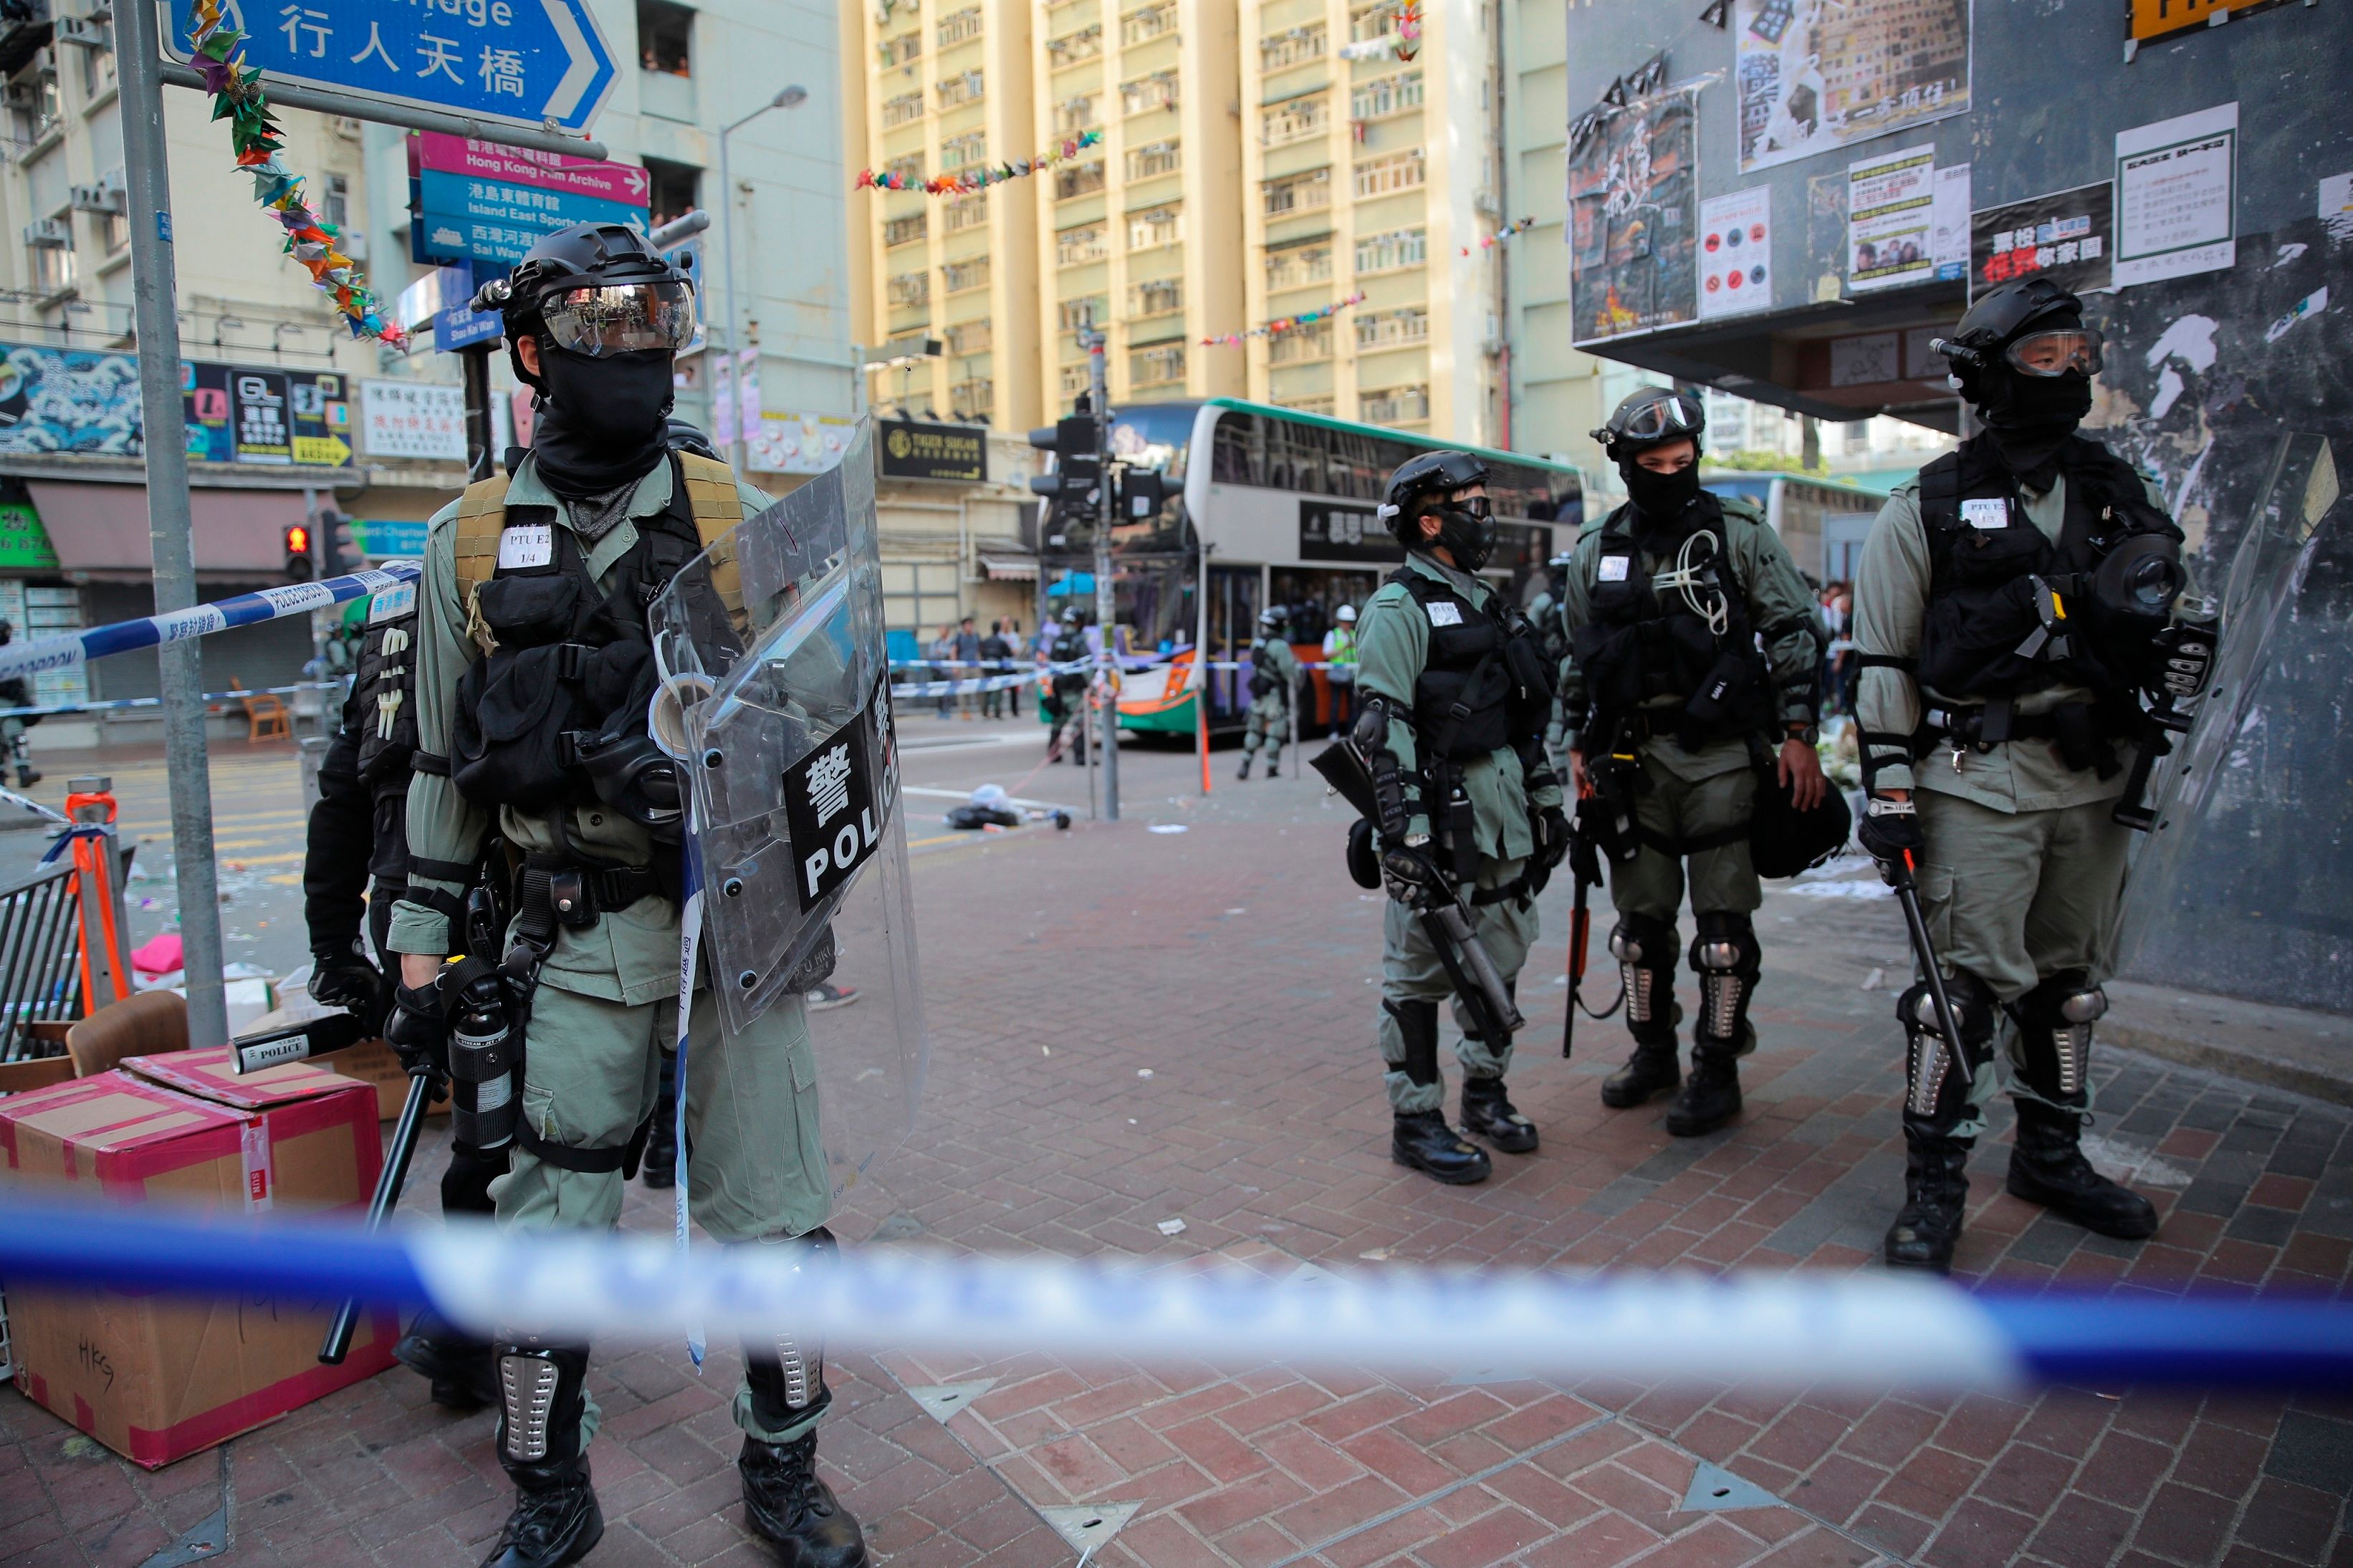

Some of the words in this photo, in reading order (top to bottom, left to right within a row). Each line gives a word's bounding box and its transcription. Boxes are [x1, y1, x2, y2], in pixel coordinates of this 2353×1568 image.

[279, 4, 525, 97] 行人天橋
[466, 154, 502, 173] Hong
[504, 162, 537, 178] Kong
[567, 173, 612, 191] Archive
[468, 183, 560, 211] 港島東體育館
[468, 203, 506, 218] Island
[509, 208, 537, 223] East
[539, 213, 577, 229] Sports
[472, 244, 496, 256] Sai
[499, 248, 522, 259] Wan
[510, 534, 534, 545] PTU
[537, 534, 550, 544] E2
[521, 553, 535, 563] 1/4
[272, 589, 299, 610] POLICE
[805, 744, 898, 899] POLICE
[260, 1042, 303, 1060] POLICE
[251, 1172, 261, 1194] SUN
[833, 1184, 845, 1199] ESP
